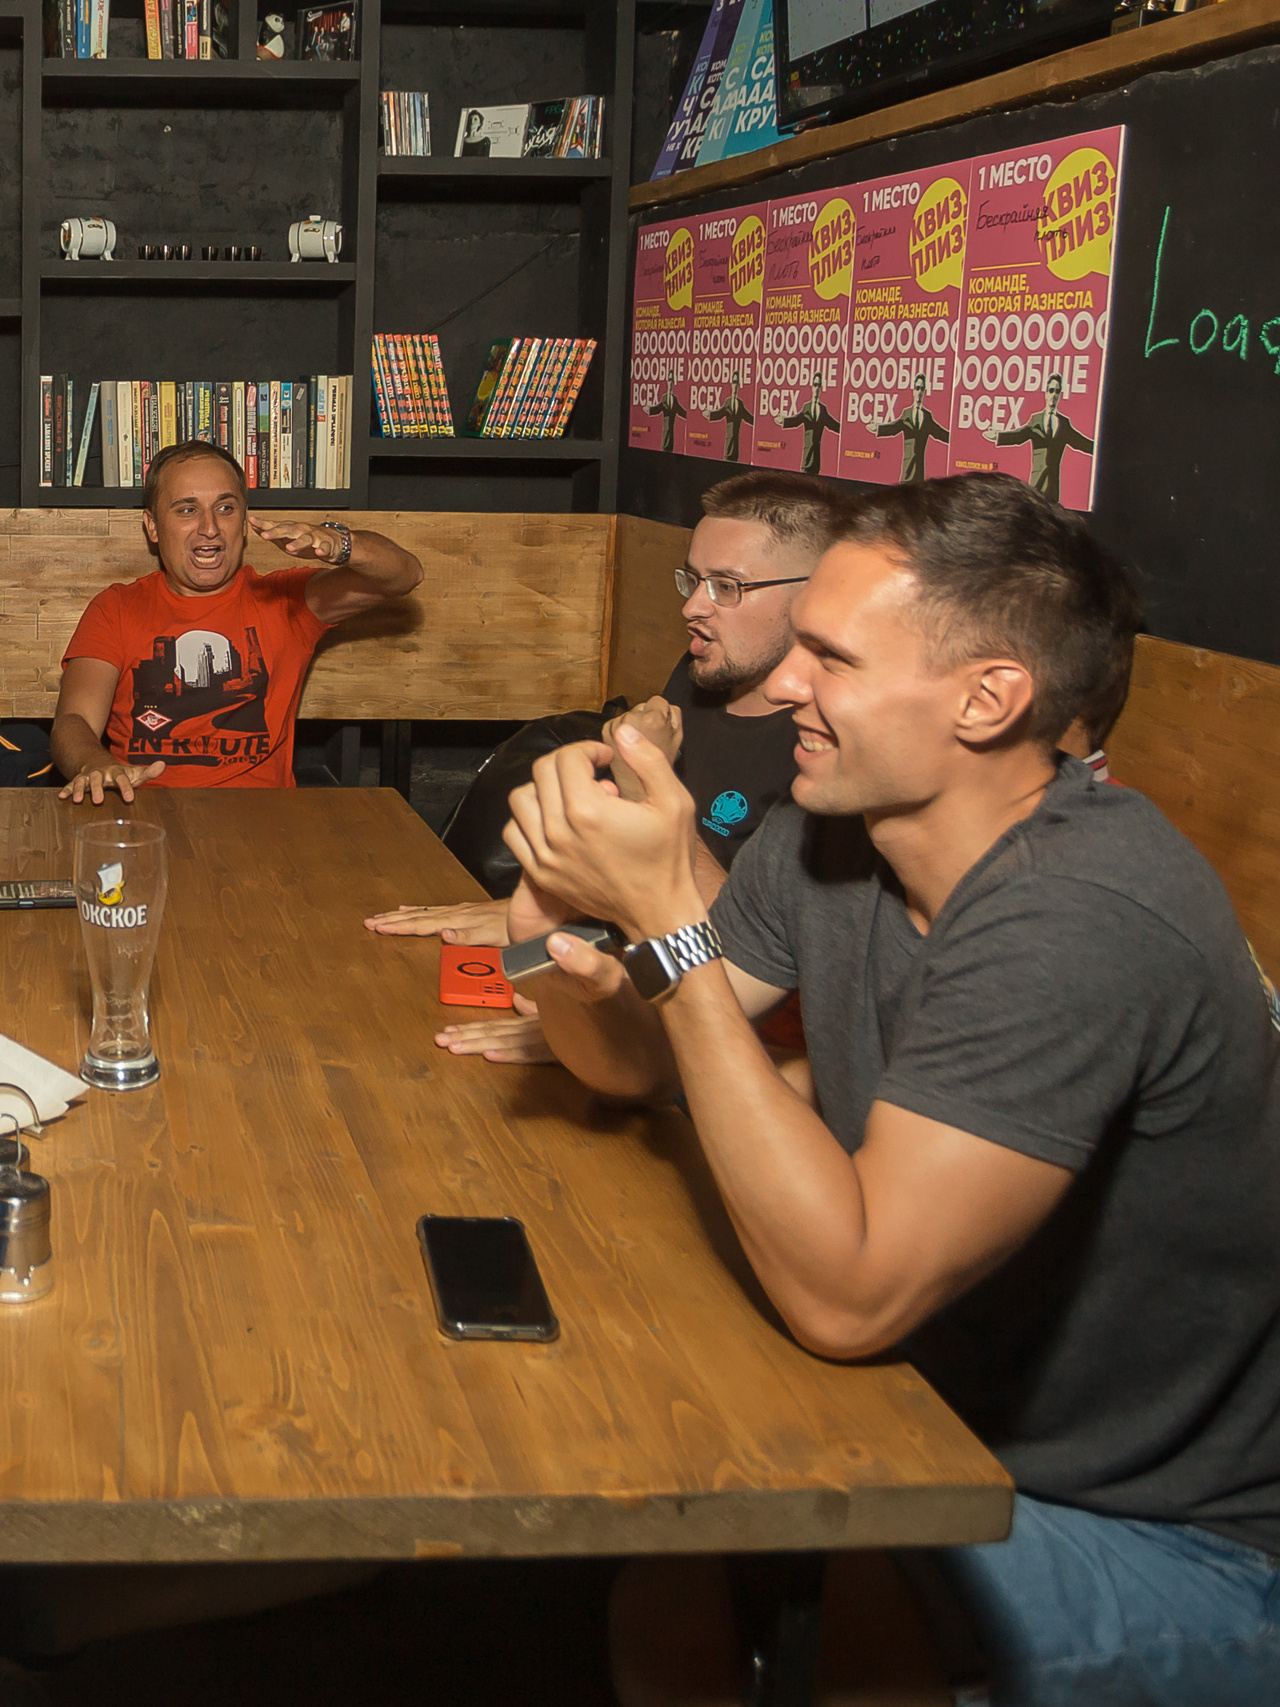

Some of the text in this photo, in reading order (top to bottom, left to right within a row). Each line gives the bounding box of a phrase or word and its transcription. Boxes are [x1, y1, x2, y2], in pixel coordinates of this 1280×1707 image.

[978, 153, 1053, 191] 1 МЕСТО
[863, 181, 920, 213] 1 МЕСТО
[778, 201, 817, 227] МЕСТО
[643, 229, 670, 250] МЕСТО
[704, 217, 737, 240] МЕСТО
[855, 286, 903, 304] КОМАНДЕ,
[968, 273, 1030, 294] КОМАНДЕ,
[854, 301, 950, 322] КОТОРАЯ РАЗНЕСЛА
[967, 290, 1094, 314] КОТОРАЯ РАЗНЕСЛА
[764, 308, 841, 325] КОТОРАЯ РАЗНЕСЛА
[632, 383, 660, 406] ВСЕХ
[689, 385, 722, 411] ВСЕХ
[759, 388, 800, 417] ВСЕХ
[847, 392, 899, 424] ВСЕХ
[958, 394, 1025, 432] ВСЕХ
[81, 900, 148, 928] ОКСКОЕ
